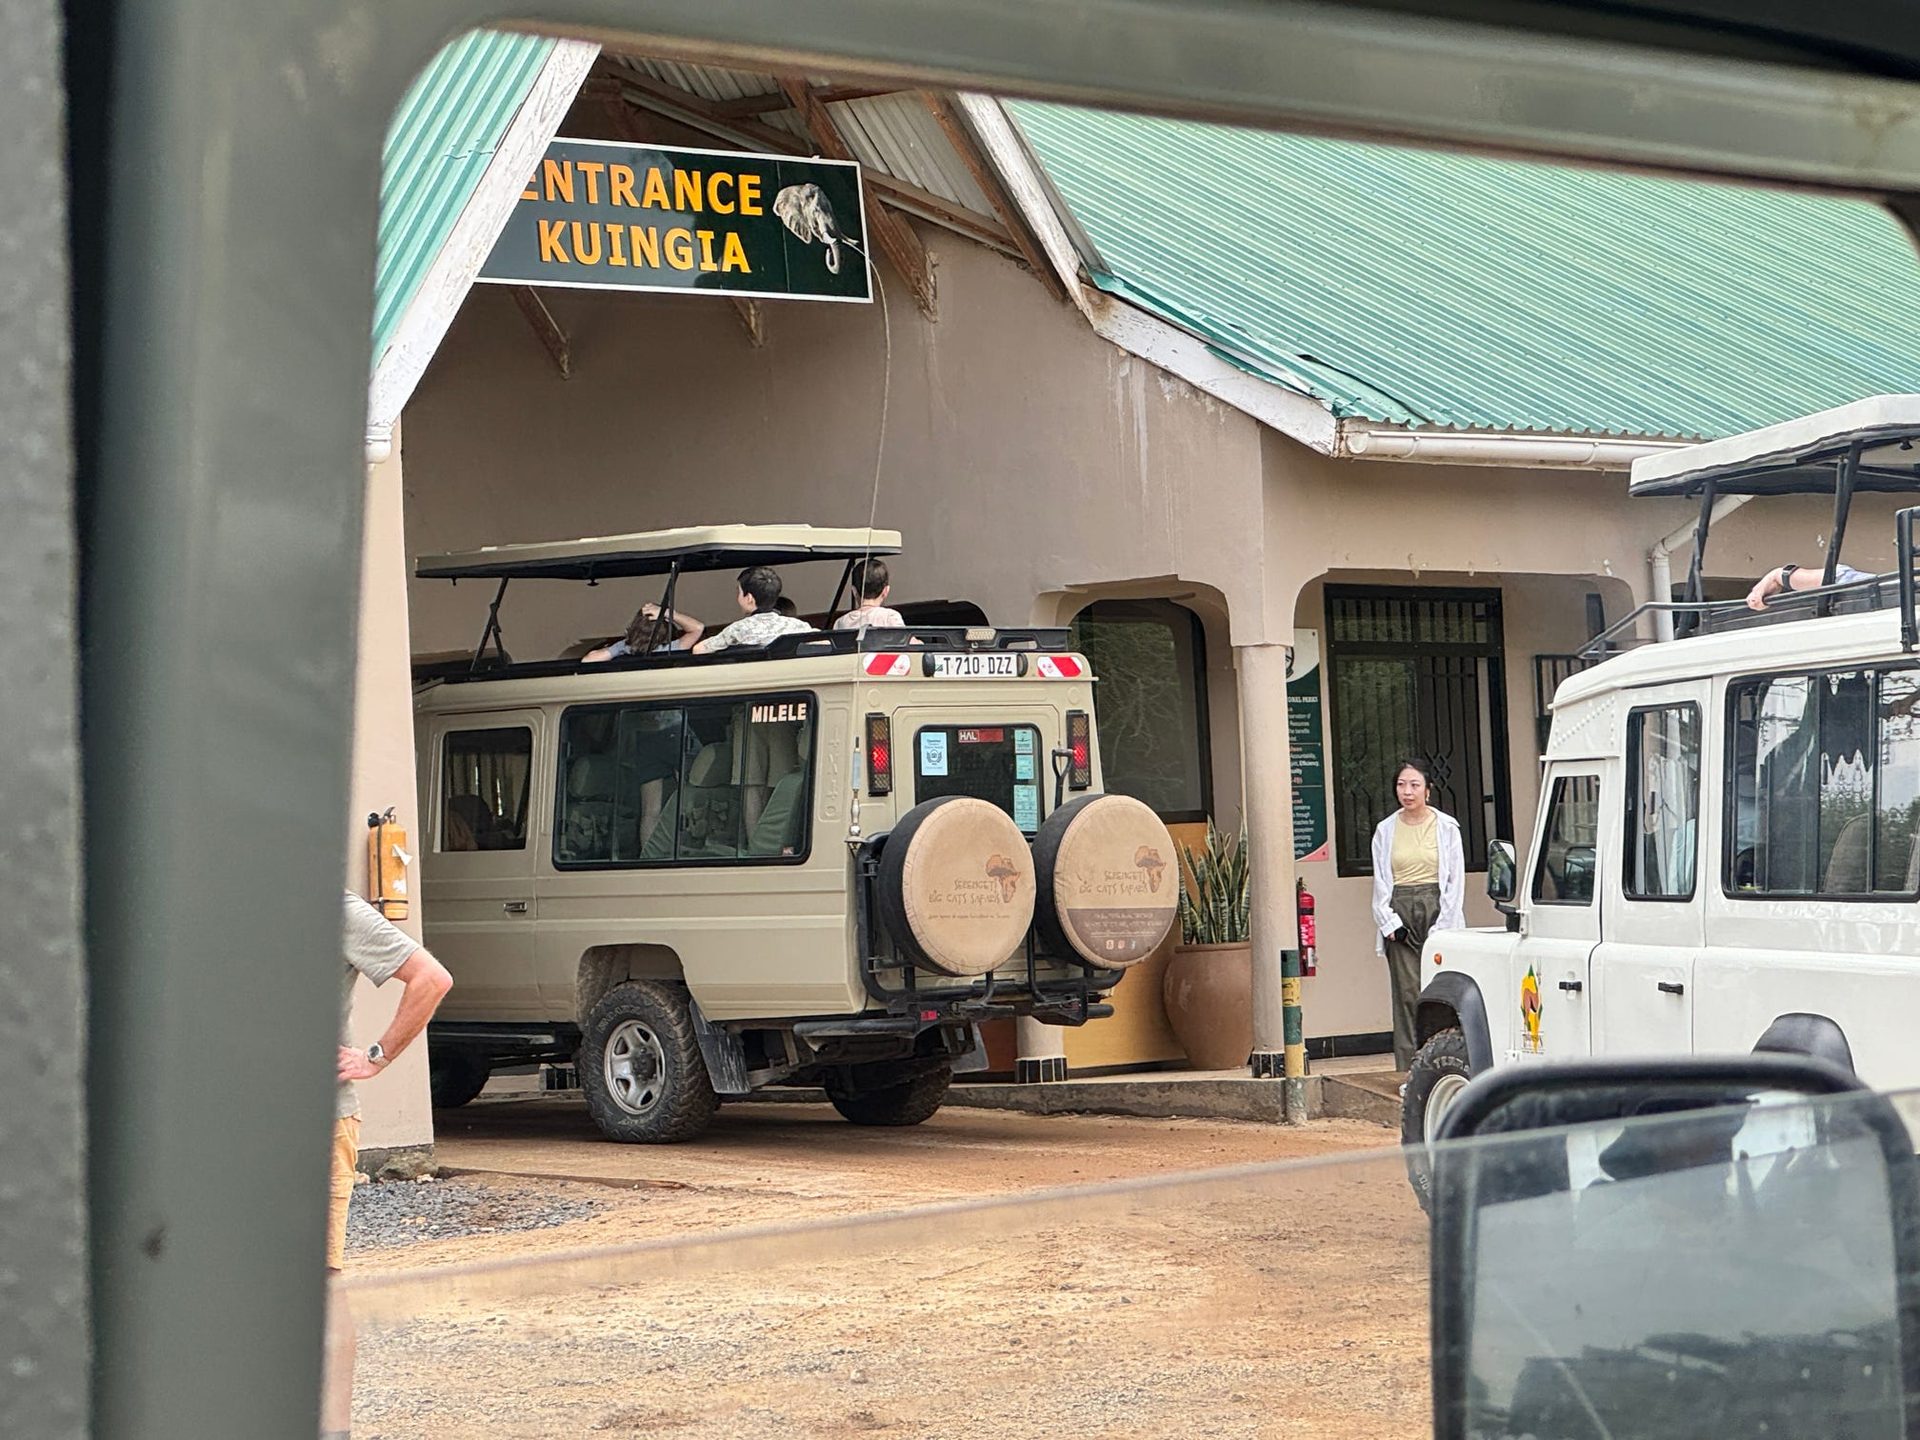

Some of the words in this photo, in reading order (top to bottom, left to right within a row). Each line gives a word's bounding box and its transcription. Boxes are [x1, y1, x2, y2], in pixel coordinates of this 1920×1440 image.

[537, 219, 752, 273] KUINGIA
[943, 656, 951, 675] T
[955, 656, 980, 675] 710
[988, 656, 1013, 675] DZZ
[751, 703, 807, 723] MILELE
